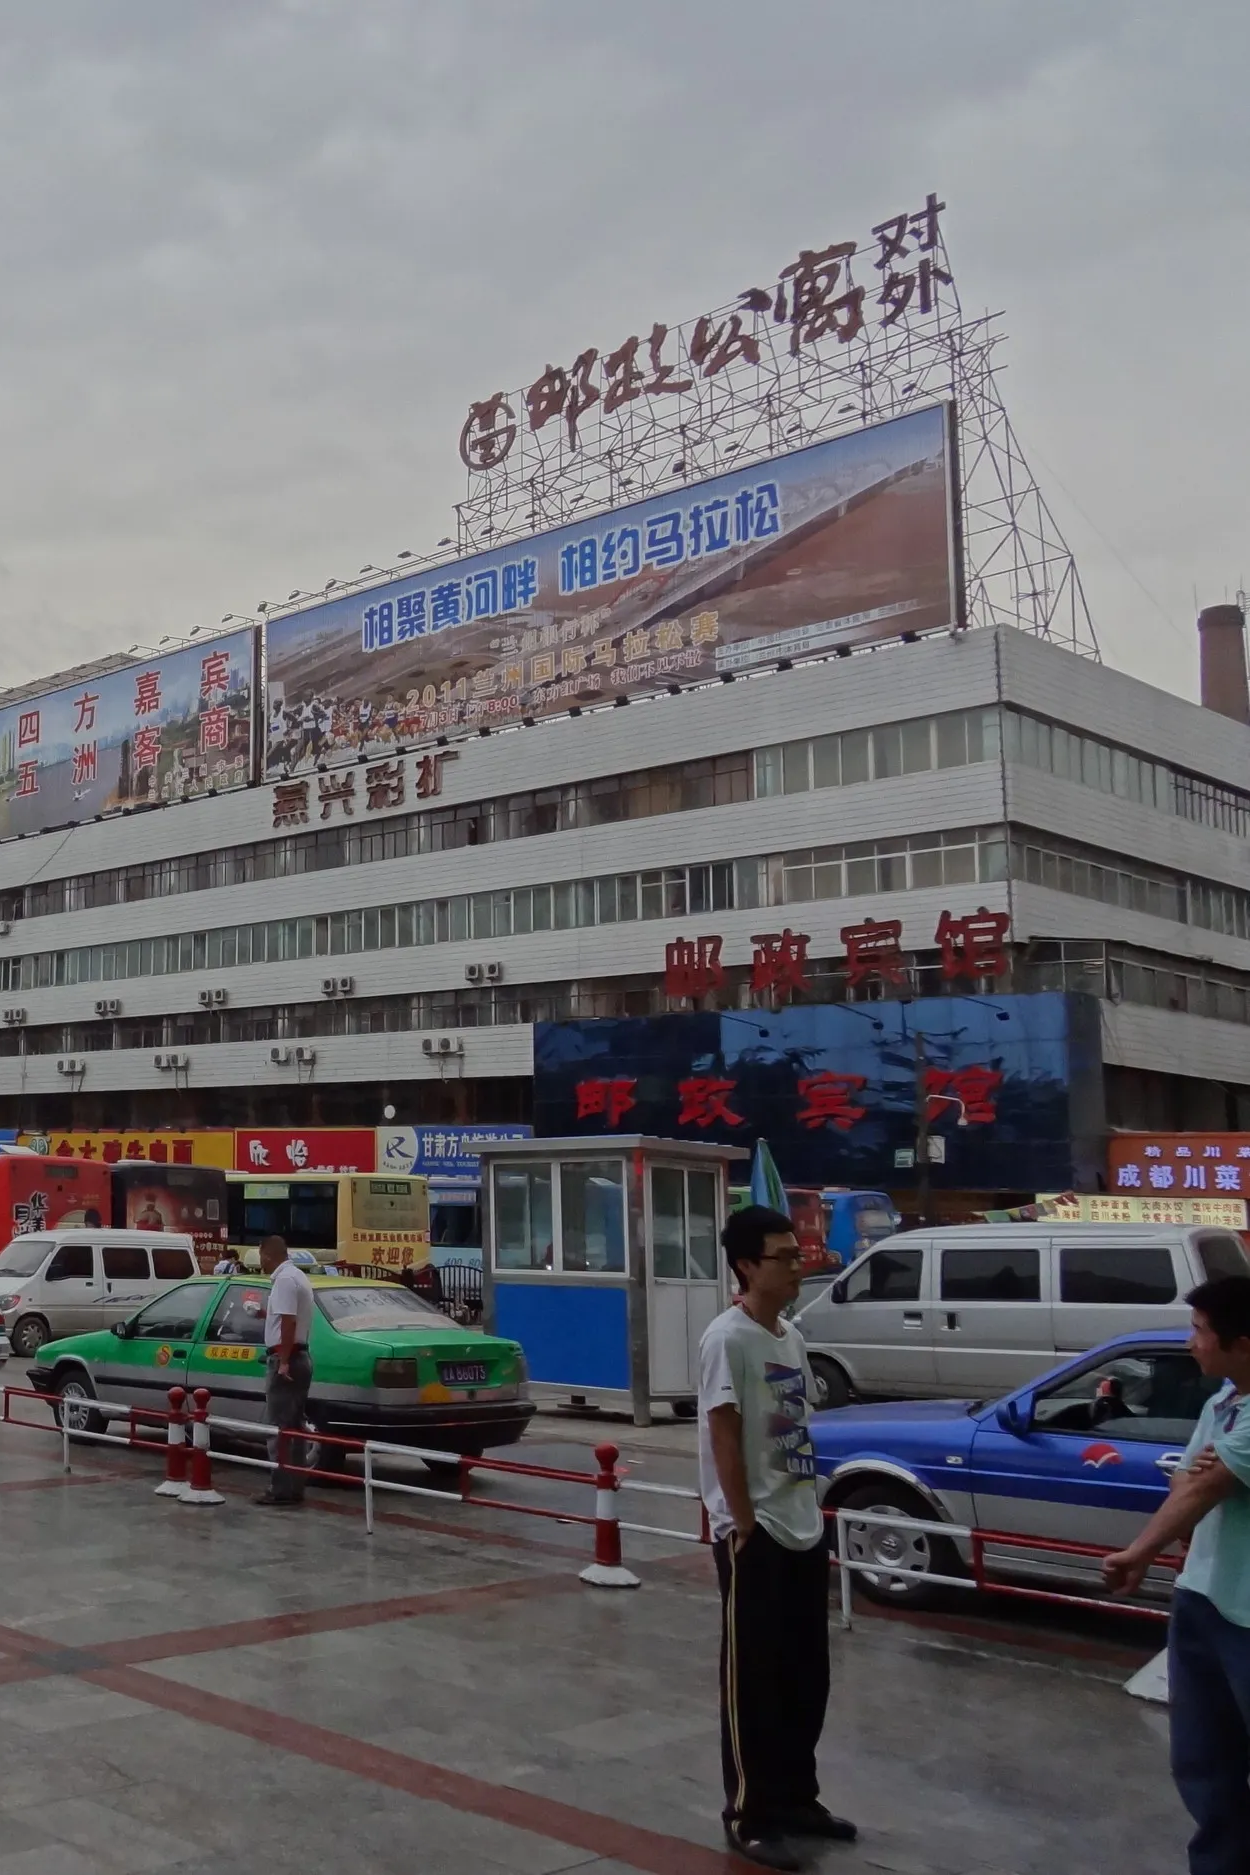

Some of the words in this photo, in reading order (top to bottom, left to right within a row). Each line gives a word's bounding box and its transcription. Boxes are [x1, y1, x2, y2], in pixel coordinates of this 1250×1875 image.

[871, 193, 953, 328] 对外
[362, 556, 540, 653] 相聚黄河畔
[558, 481, 780, 597] 相约马拉松
[664, 907, 1011, 997] 邮政宾馆
[575, 1066, 1005, 1129] 邮政宾馆
[1117, 1164, 1240, 1190] 成都川菜
